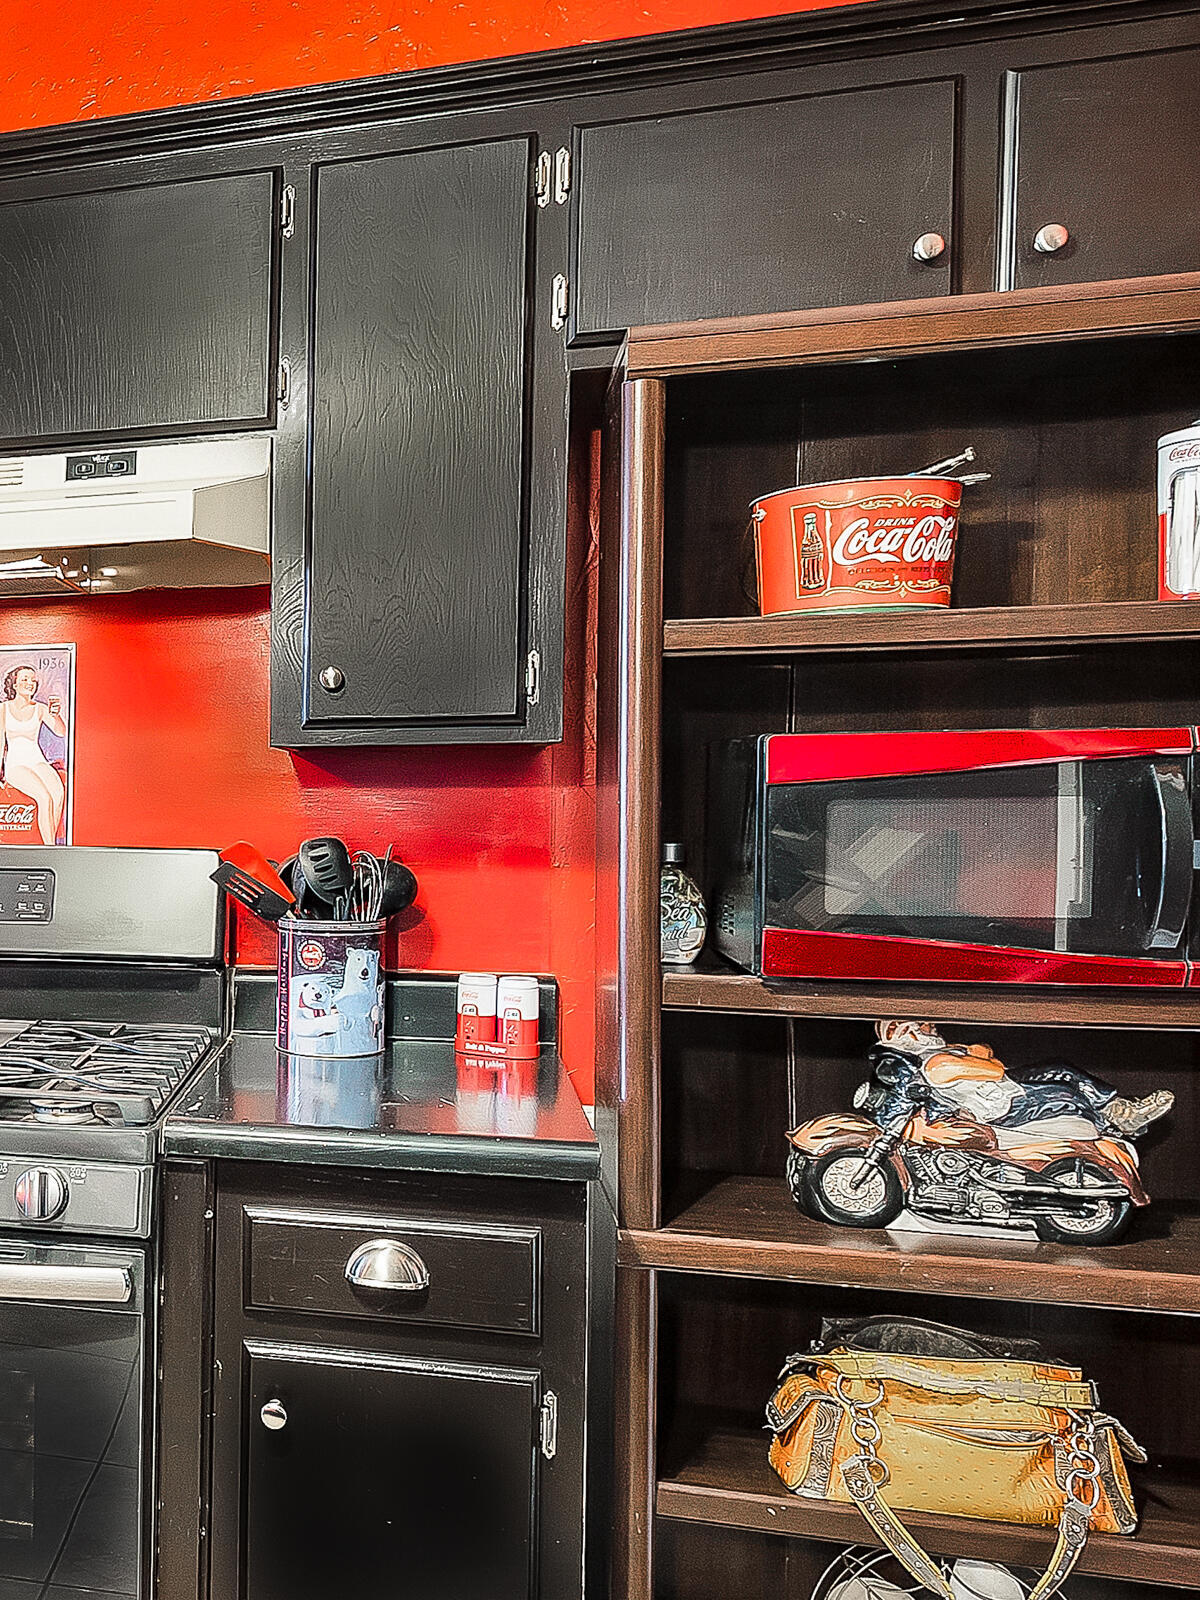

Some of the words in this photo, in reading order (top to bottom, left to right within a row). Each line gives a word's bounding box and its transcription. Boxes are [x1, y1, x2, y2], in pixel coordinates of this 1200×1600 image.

[873, 517, 917, 528] DRINK
[833, 513, 955, 566] Coca-Cola
[38, 658, 65, 671] 1936
